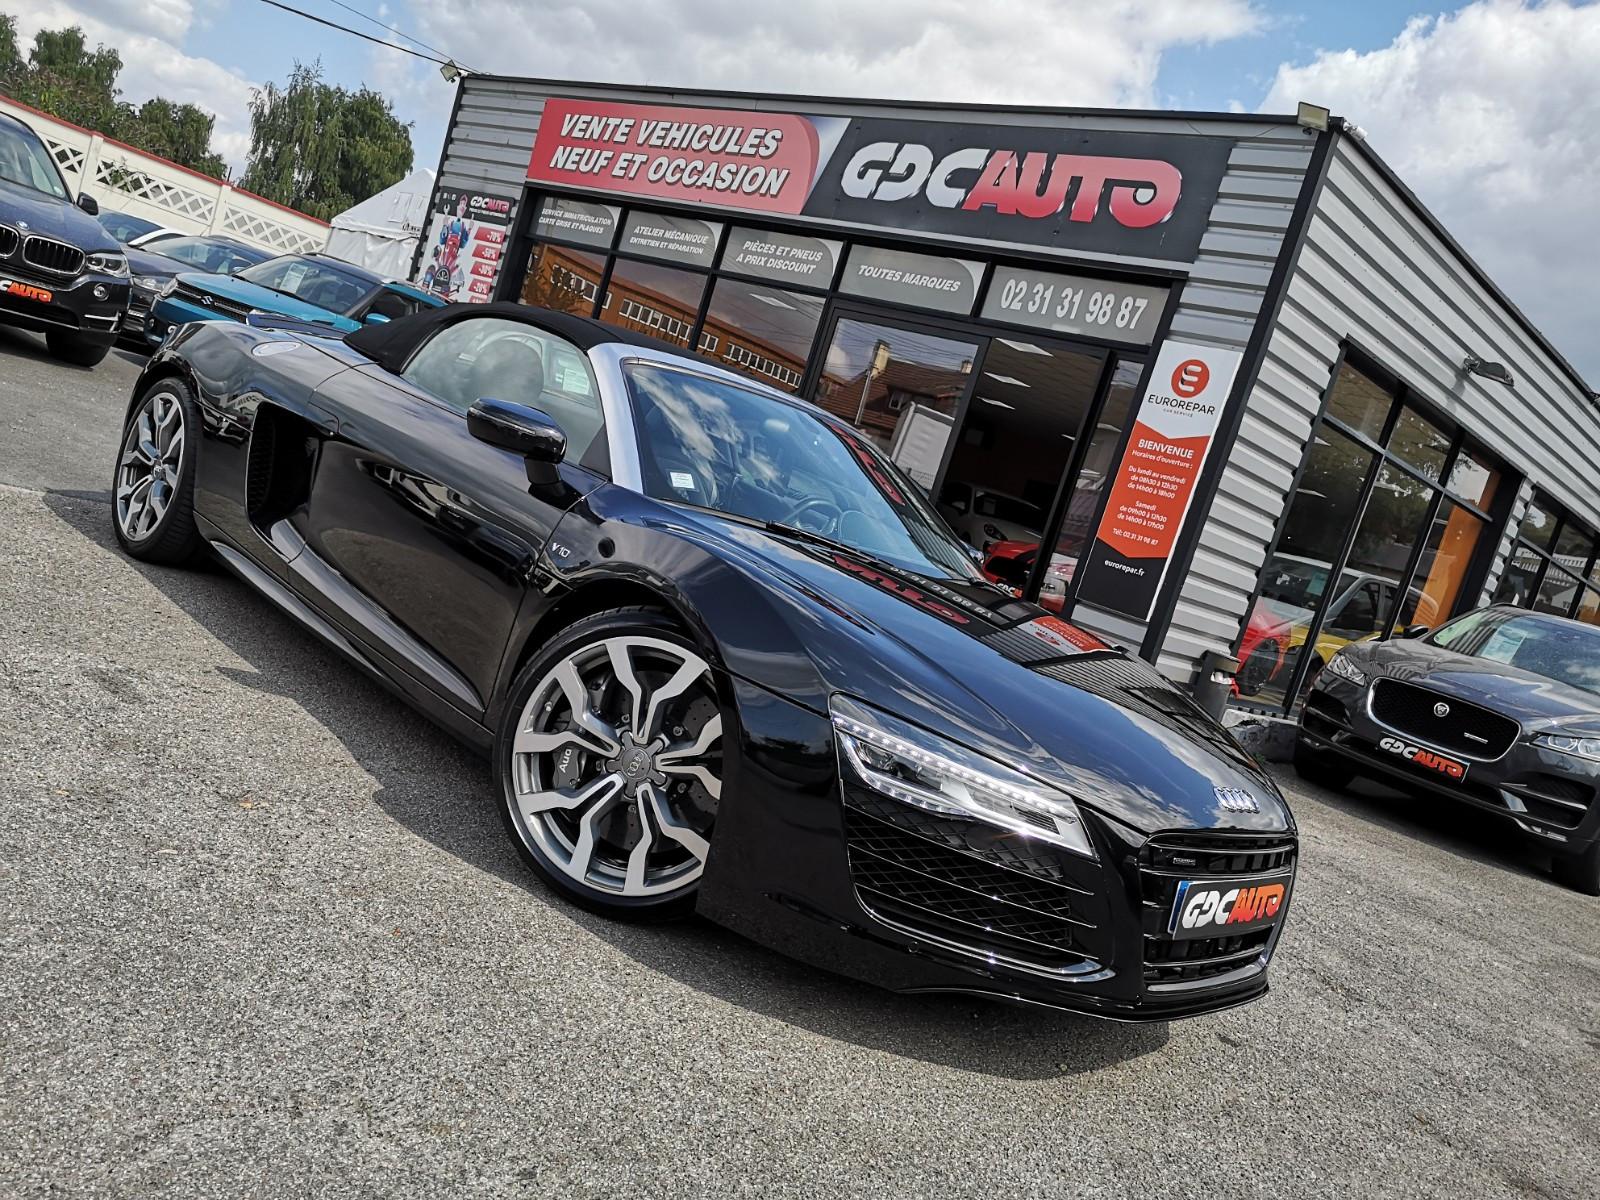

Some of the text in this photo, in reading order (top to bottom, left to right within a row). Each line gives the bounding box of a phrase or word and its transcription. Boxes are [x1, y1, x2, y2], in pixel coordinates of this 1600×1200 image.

[560, 113, 783, 158] VENTE VEHICULES
[550, 145, 790, 196] NEUF ET OCCASION
[539, 217, 556, 225] CARTE
[556, 219, 571, 228] GRISE
[579, 223, 604, 234] PLAQUES
[541, 208, 612, 226] SERVICE IMMATRICULATION
[633, 225, 709, 244] ATELIER MÉCANIQUE
[629, 236, 704, 254] ENTRETIEN ET RÉPARATION
[742, 240, 823, 262] PIÈCES ET PNEUS
[745, 254, 767, 266] PRIX
[767, 258, 816, 275] DISCOUNT
[857, 265, 961, 292] TOUTES MARQUES
[1001, 279, 1148, 329] 02 31 31 98 87
[1147, 394, 1216, 415] EUROREPAR
[1131, 450, 1156, 460] Horaires
[1138, 439, 1194, 459] BIENVENUE
[1137, 467, 1152, 476] lundi
[1160, 474, 1186, 484] vendredi
[1136, 483, 1153, 493] 14h00
[1135, 500, 1157, 511] Samedi
[1117, 512, 1125, 520] de
[1104, 559, 1145, 577] eurorepar.fr
